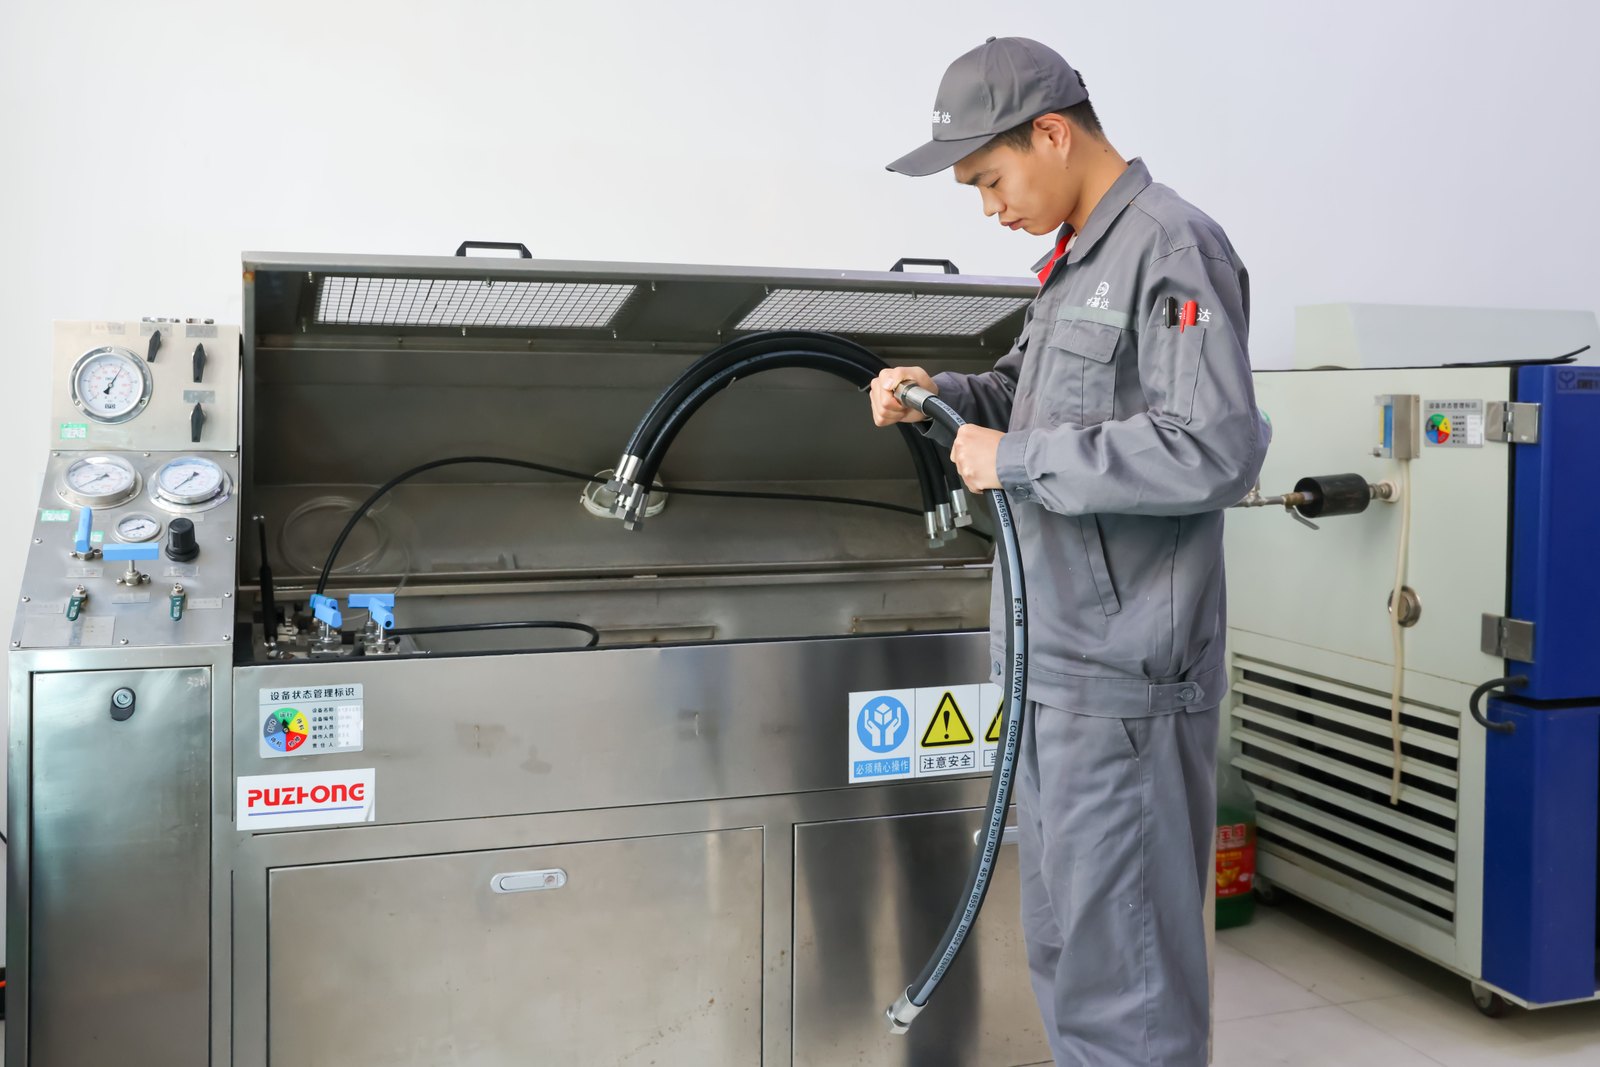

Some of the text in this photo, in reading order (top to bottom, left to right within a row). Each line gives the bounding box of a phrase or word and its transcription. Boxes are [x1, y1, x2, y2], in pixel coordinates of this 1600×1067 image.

[1014, 653, 1023, 702] RAILWAY
[270, 687, 355, 701] 设备状态管理标识
[1005, 720, 1018, 762] EC045-12
[855, 759, 909, 775] 必须精心操作
[923, 754, 971, 770] 注意安全
[1001, 768, 1010, 786] 19.0
[247, 783, 365, 808] PUZHONG
[996, 788, 1004, 805] mm
[983, 841, 995, 863] DN19
[979, 867, 988, 878] 45
[976, 879, 985, 891] bar
